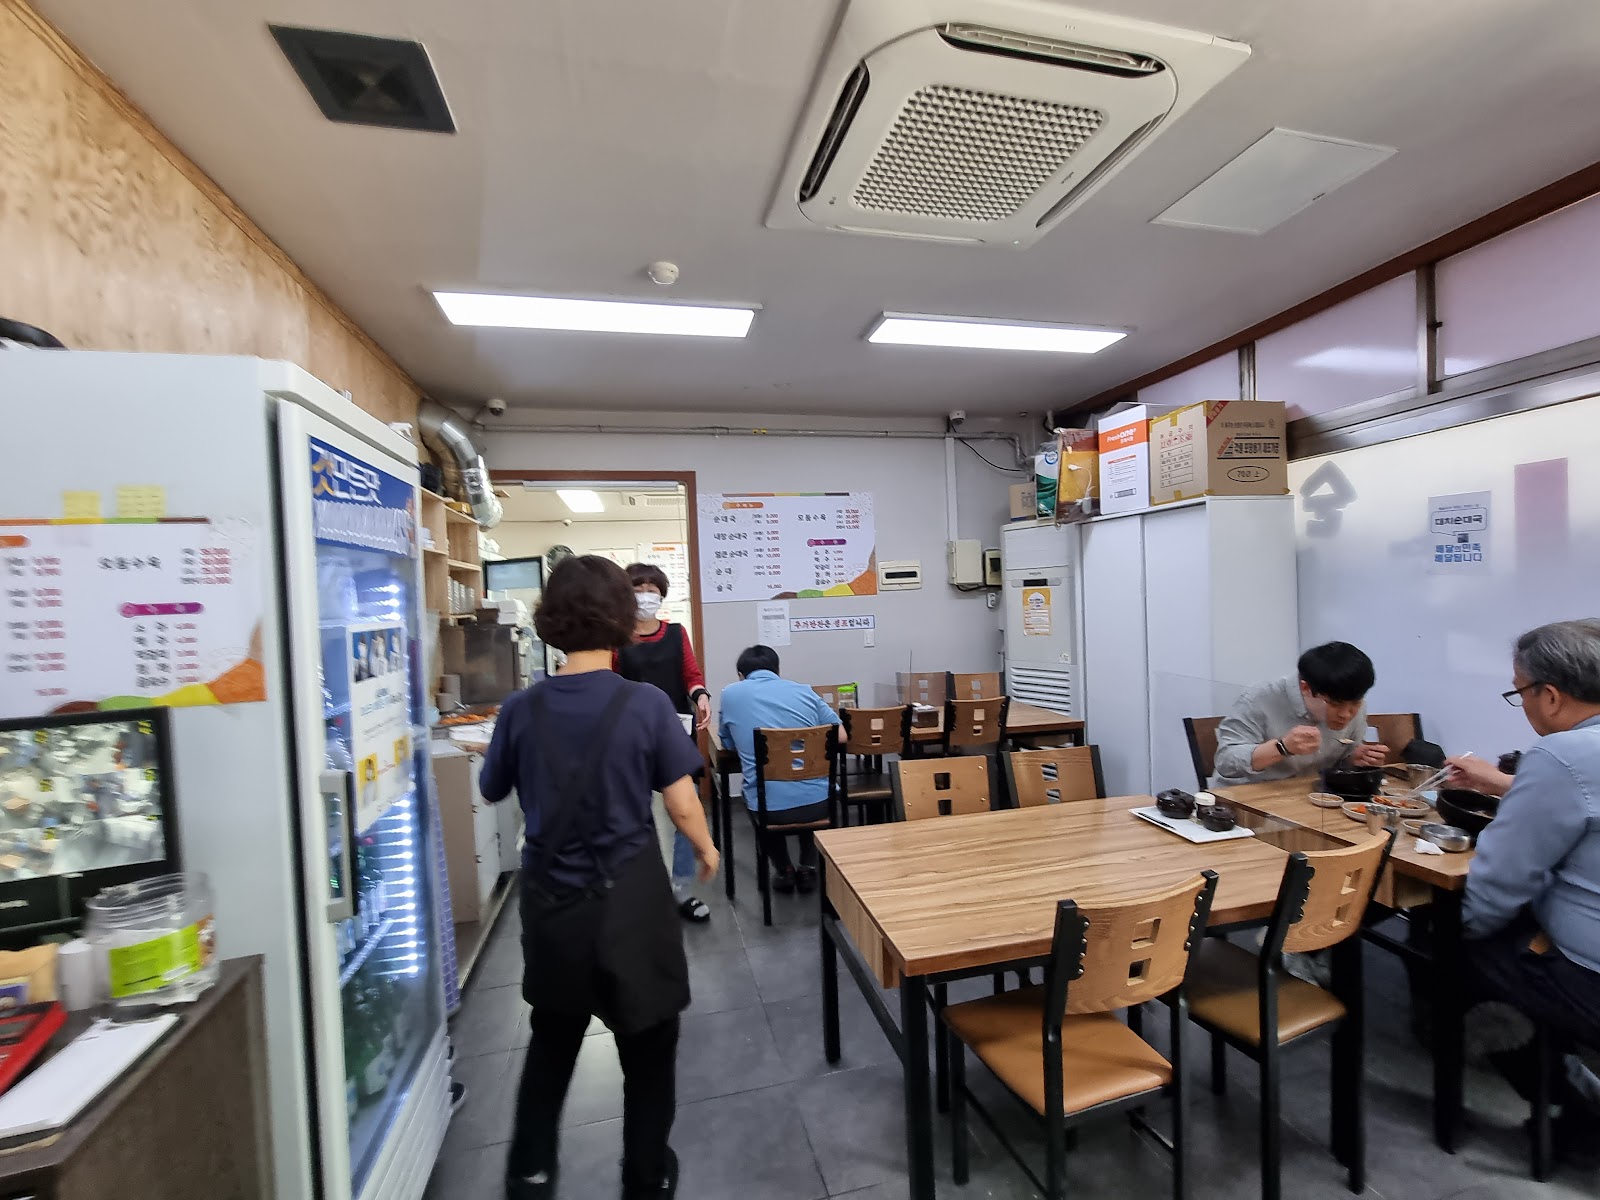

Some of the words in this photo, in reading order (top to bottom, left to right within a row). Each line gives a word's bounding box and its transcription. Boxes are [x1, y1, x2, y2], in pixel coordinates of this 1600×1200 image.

[713, 515, 736, 523] 순대국
[1434, 514, 1483, 526] 대치순대국
[729, 550, 749, 558] 순대국
